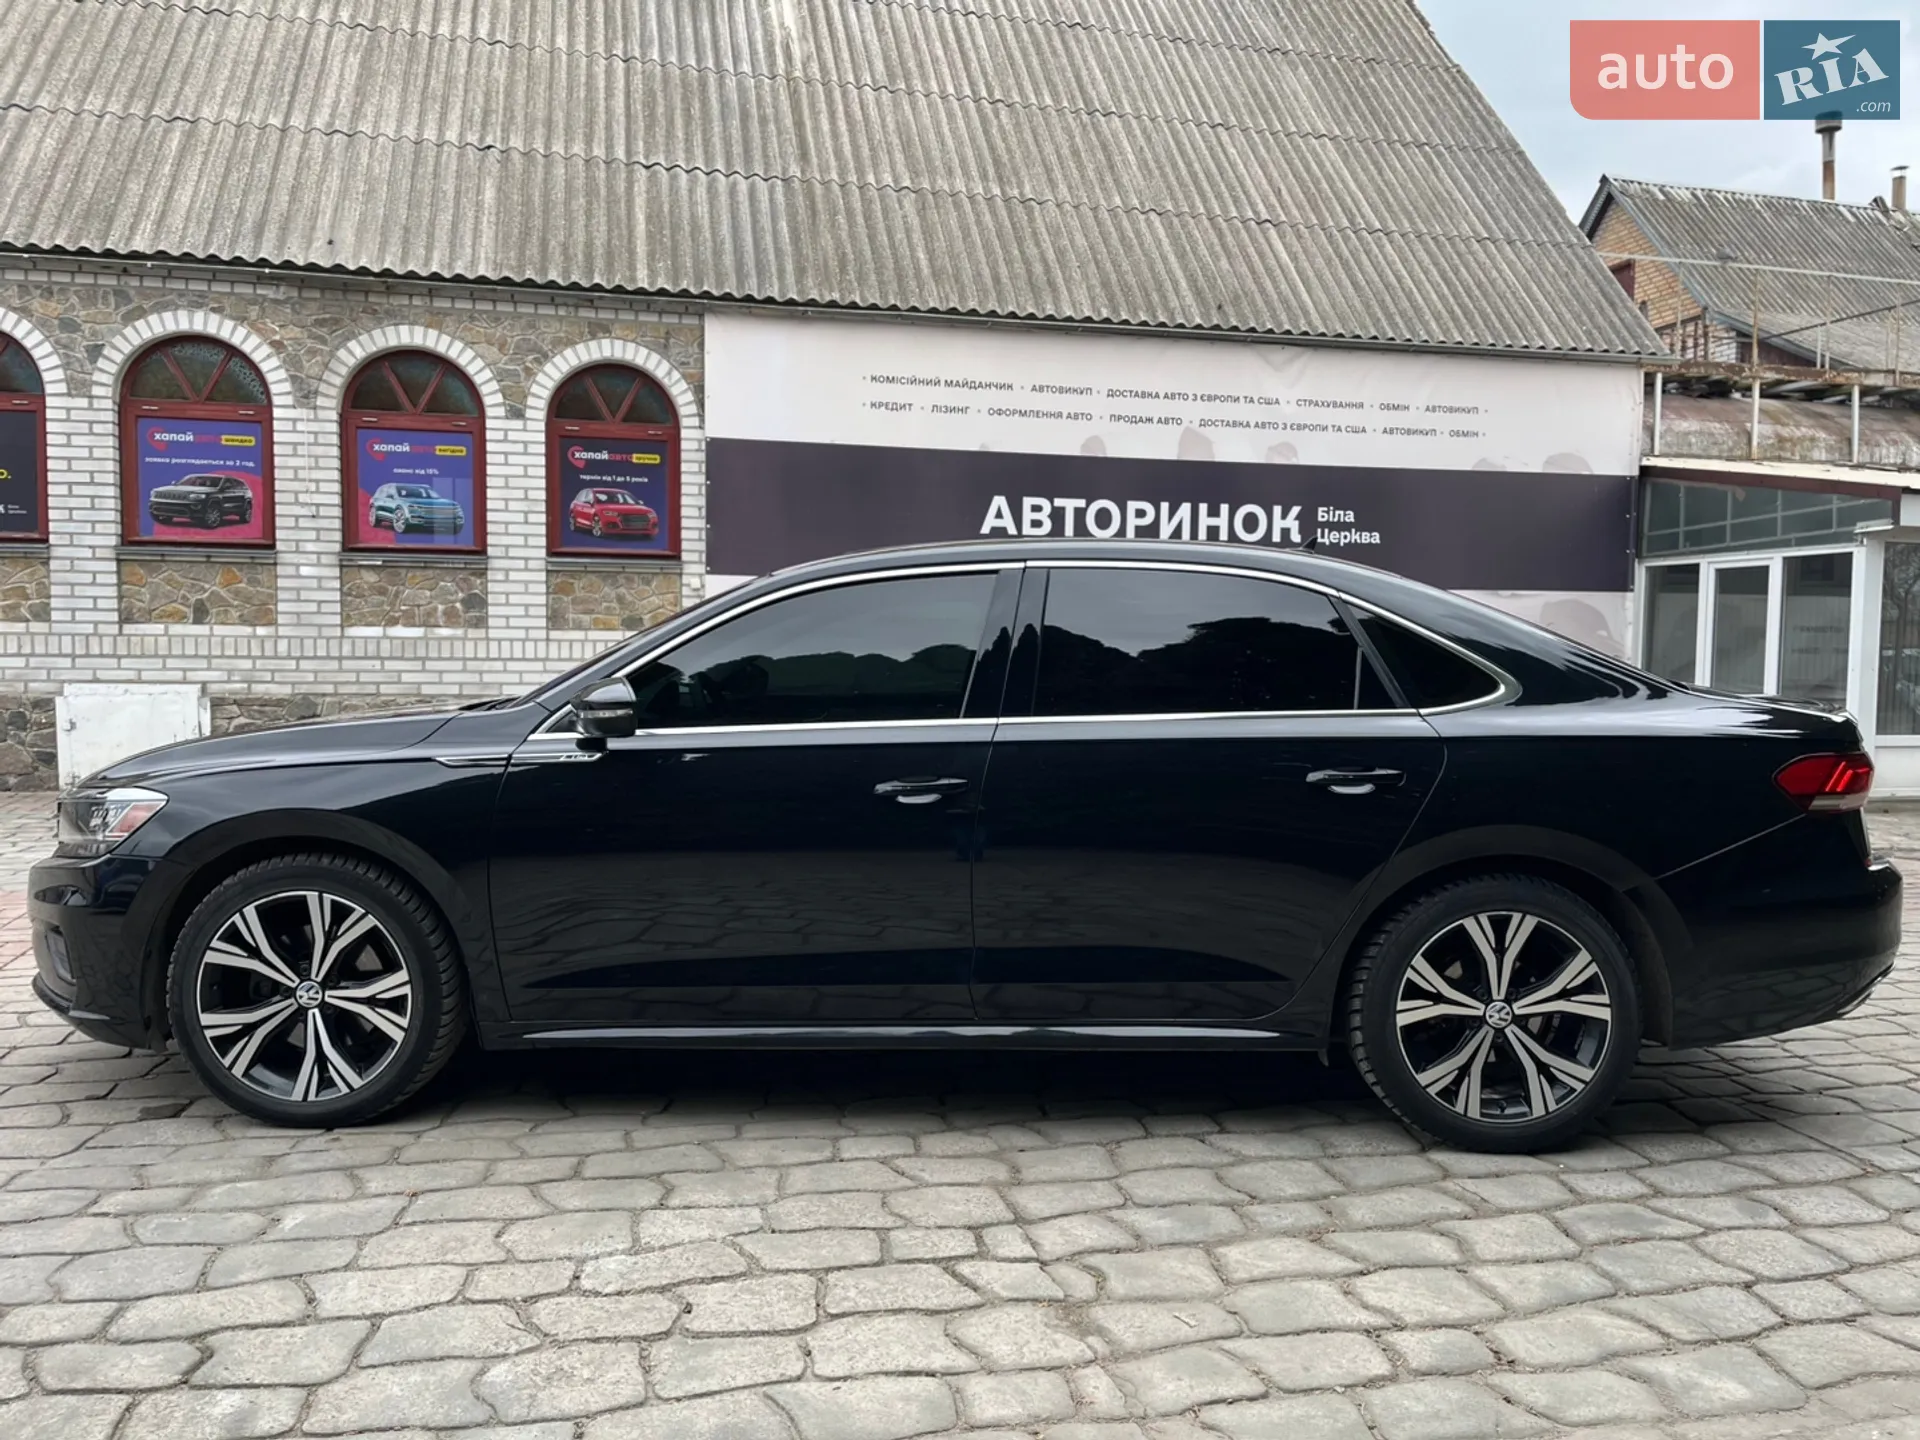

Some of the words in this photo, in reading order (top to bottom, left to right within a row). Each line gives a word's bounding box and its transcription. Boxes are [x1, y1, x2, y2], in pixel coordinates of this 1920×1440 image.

[871, 375, 941, 387] КОМІСІЙНИЙ
[944, 378, 1013, 391] МАЙДАНЧИК
[1031, 384, 1092, 396] АВТОВИКУП
[1107, 389, 1160, 399] ДОСТАВКА
[1163, 392, 1189, 401] АВТО
[1200, 394, 1240, 403] ЄВРОПИ
[1243, 396, 1255, 404] ТА
[1257, 397, 1280, 405] США
[1296, 399, 1364, 409] СТРАХУВАННЯ
[1379, 403, 1410, 411] ОБМІН
[1425, 405, 1478, 414] АВТОВИКУП
[870, 401, 913, 412] КРЕДИТ
[931, 405, 970, 414] ЛІЗИНГ
[988, 407, 1063, 419] ОФОРМЛЕННЯ
[1066, 412, 1093, 421] АВТО
[1110, 414, 1154, 425] ПРОДАЖ
[1156, 417, 1182, 426] АВТО
[1199, 419, 1251, 428] ДОСТАВКА
[1254, 421, 1279, 430] АВТО
[1290, 423, 1328, 432] ЄВРОПИ
[1345, 425, 1367, 434] США
[1382, 427, 1437, 436] АВТОВИКУП
[1449, 430, 1478, 438] ОБМІН
[979, 495, 1302, 543] АВТОРИНОК
[1317, 506, 1355, 522] Біла
[1317, 528, 1380, 546] Церква
